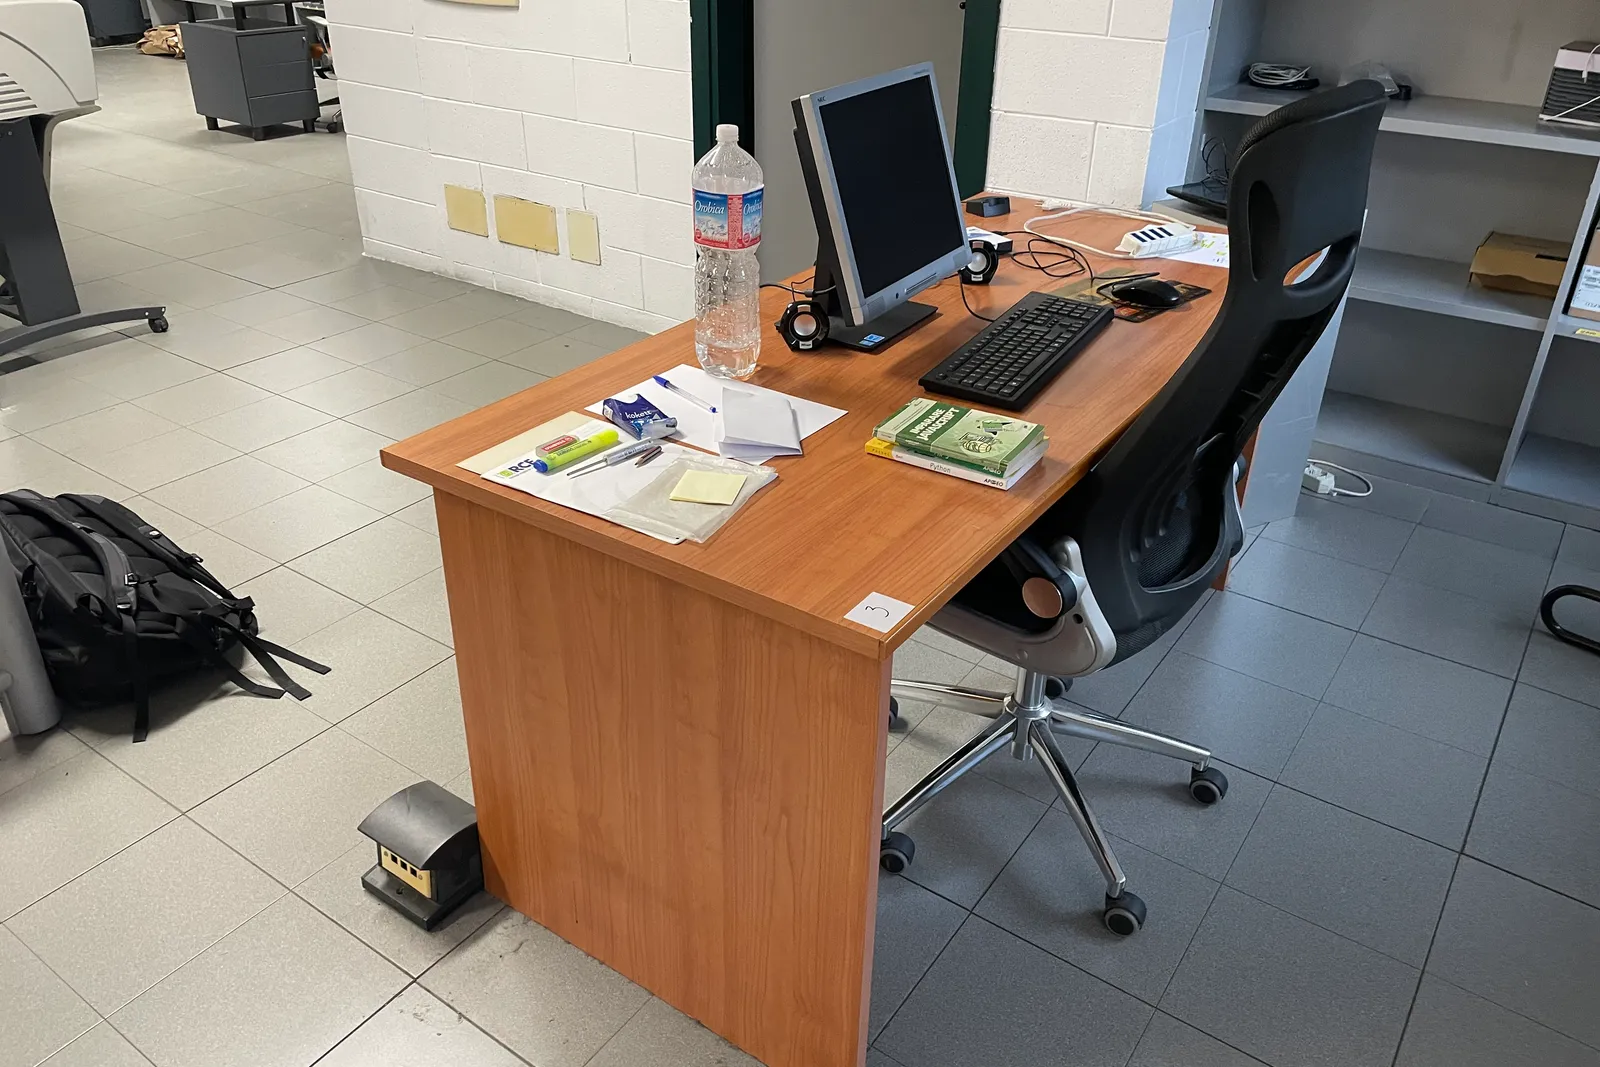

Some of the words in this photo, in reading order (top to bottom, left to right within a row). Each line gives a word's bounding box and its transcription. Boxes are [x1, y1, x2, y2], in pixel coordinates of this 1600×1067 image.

[695, 200, 724, 214] Orobica
[909, 408, 946, 434] IMPARARE
[916, 407, 960, 441] JAVASCRIPT
[929, 462, 951, 474] Python
[865, 605, 890, 618] 3
